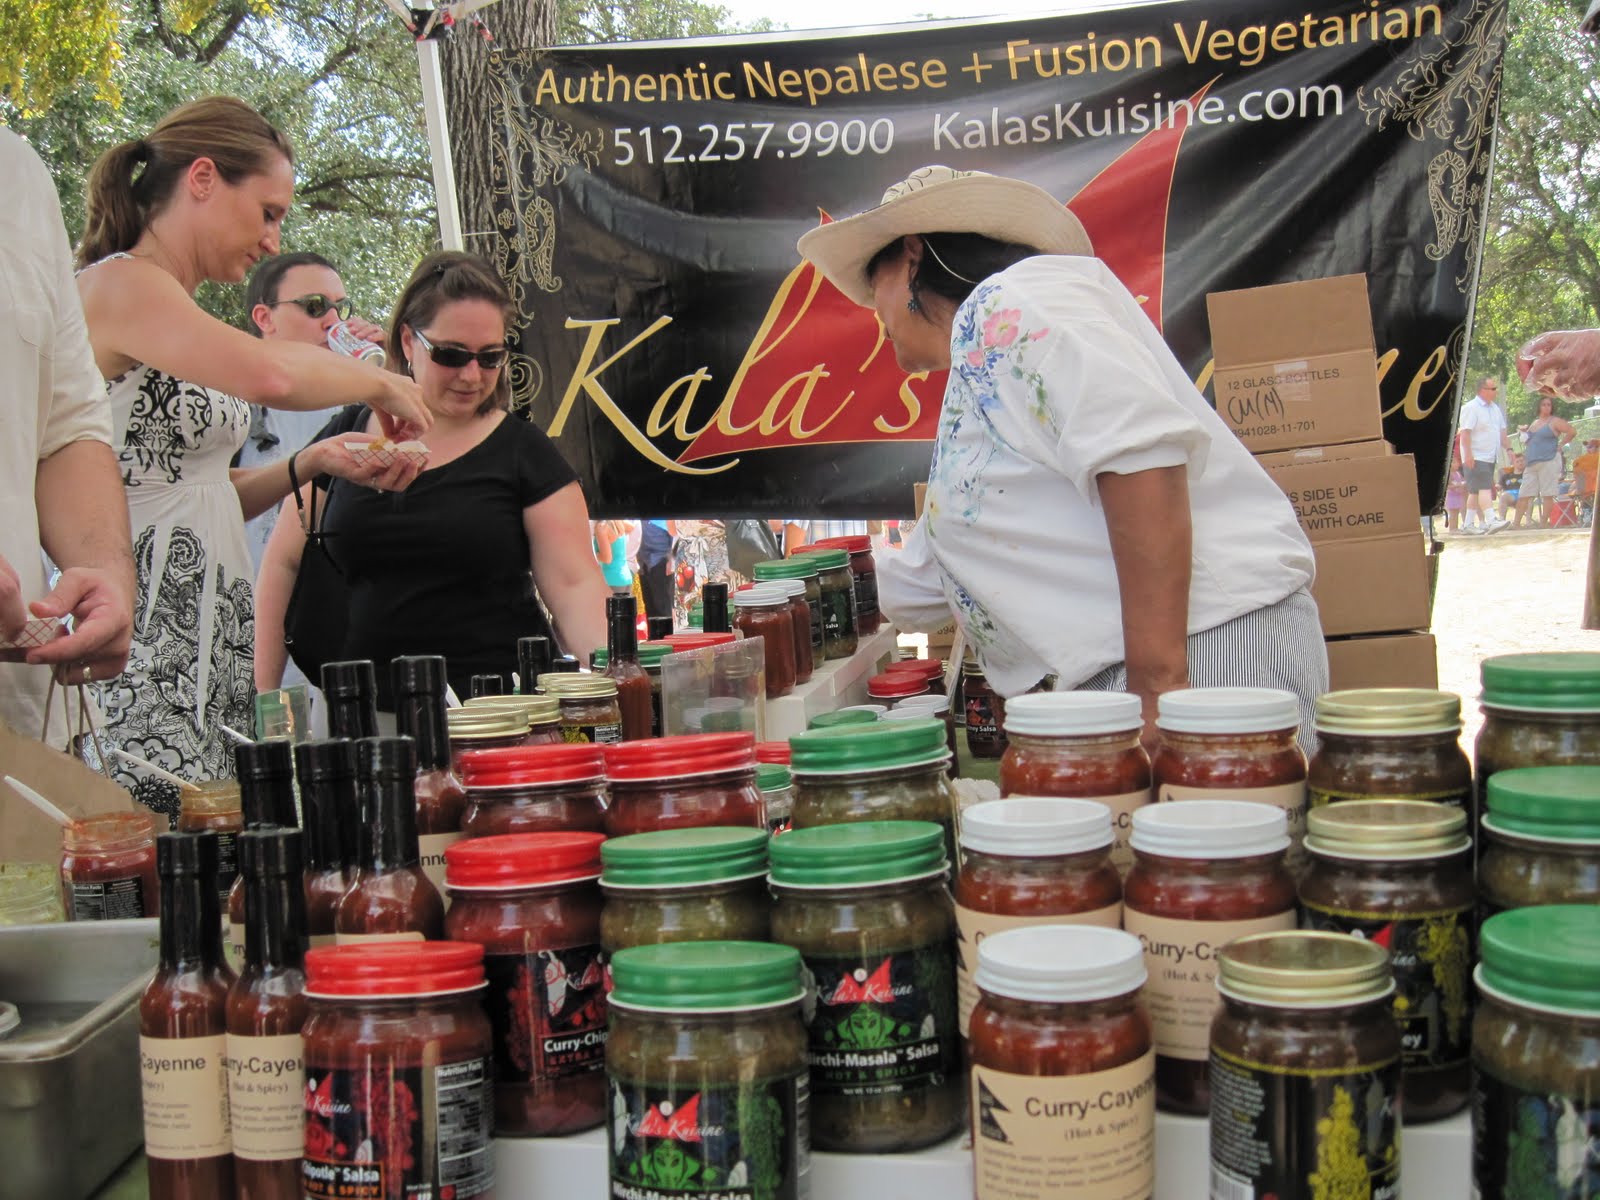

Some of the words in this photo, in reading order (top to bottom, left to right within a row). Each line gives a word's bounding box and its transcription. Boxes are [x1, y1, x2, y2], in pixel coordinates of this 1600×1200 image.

[535, 62, 736, 105] Authentic
[743, 52, 948, 106] Nepalese
[961, 52, 993, 83] +
[1007, 32, 1162, 80] Fusion
[1174, 1, 1442, 68] Vegetarian
[614, 118, 895, 165] 512.257.9900
[933, 83, 1343, 151] KalasKuisine.com
[546, 258, 930, 475] Kala's
[1228, 381, 1240, 391] 12
[1243, 375, 1282, 389] GLASS
[1285, 368, 1340, 384] BOTTLES
[1303, 488, 1334, 502] SIDE
[1338, 485, 1358, 498] UP
[1295, 503, 1338, 517] GLASS
[1307, 516, 1343, 530] WITH
[1346, 512, 1384, 525] CARE
[906, 1042, 939, 1060] Salsa
[342, 1166, 380, 1182] Salsa
